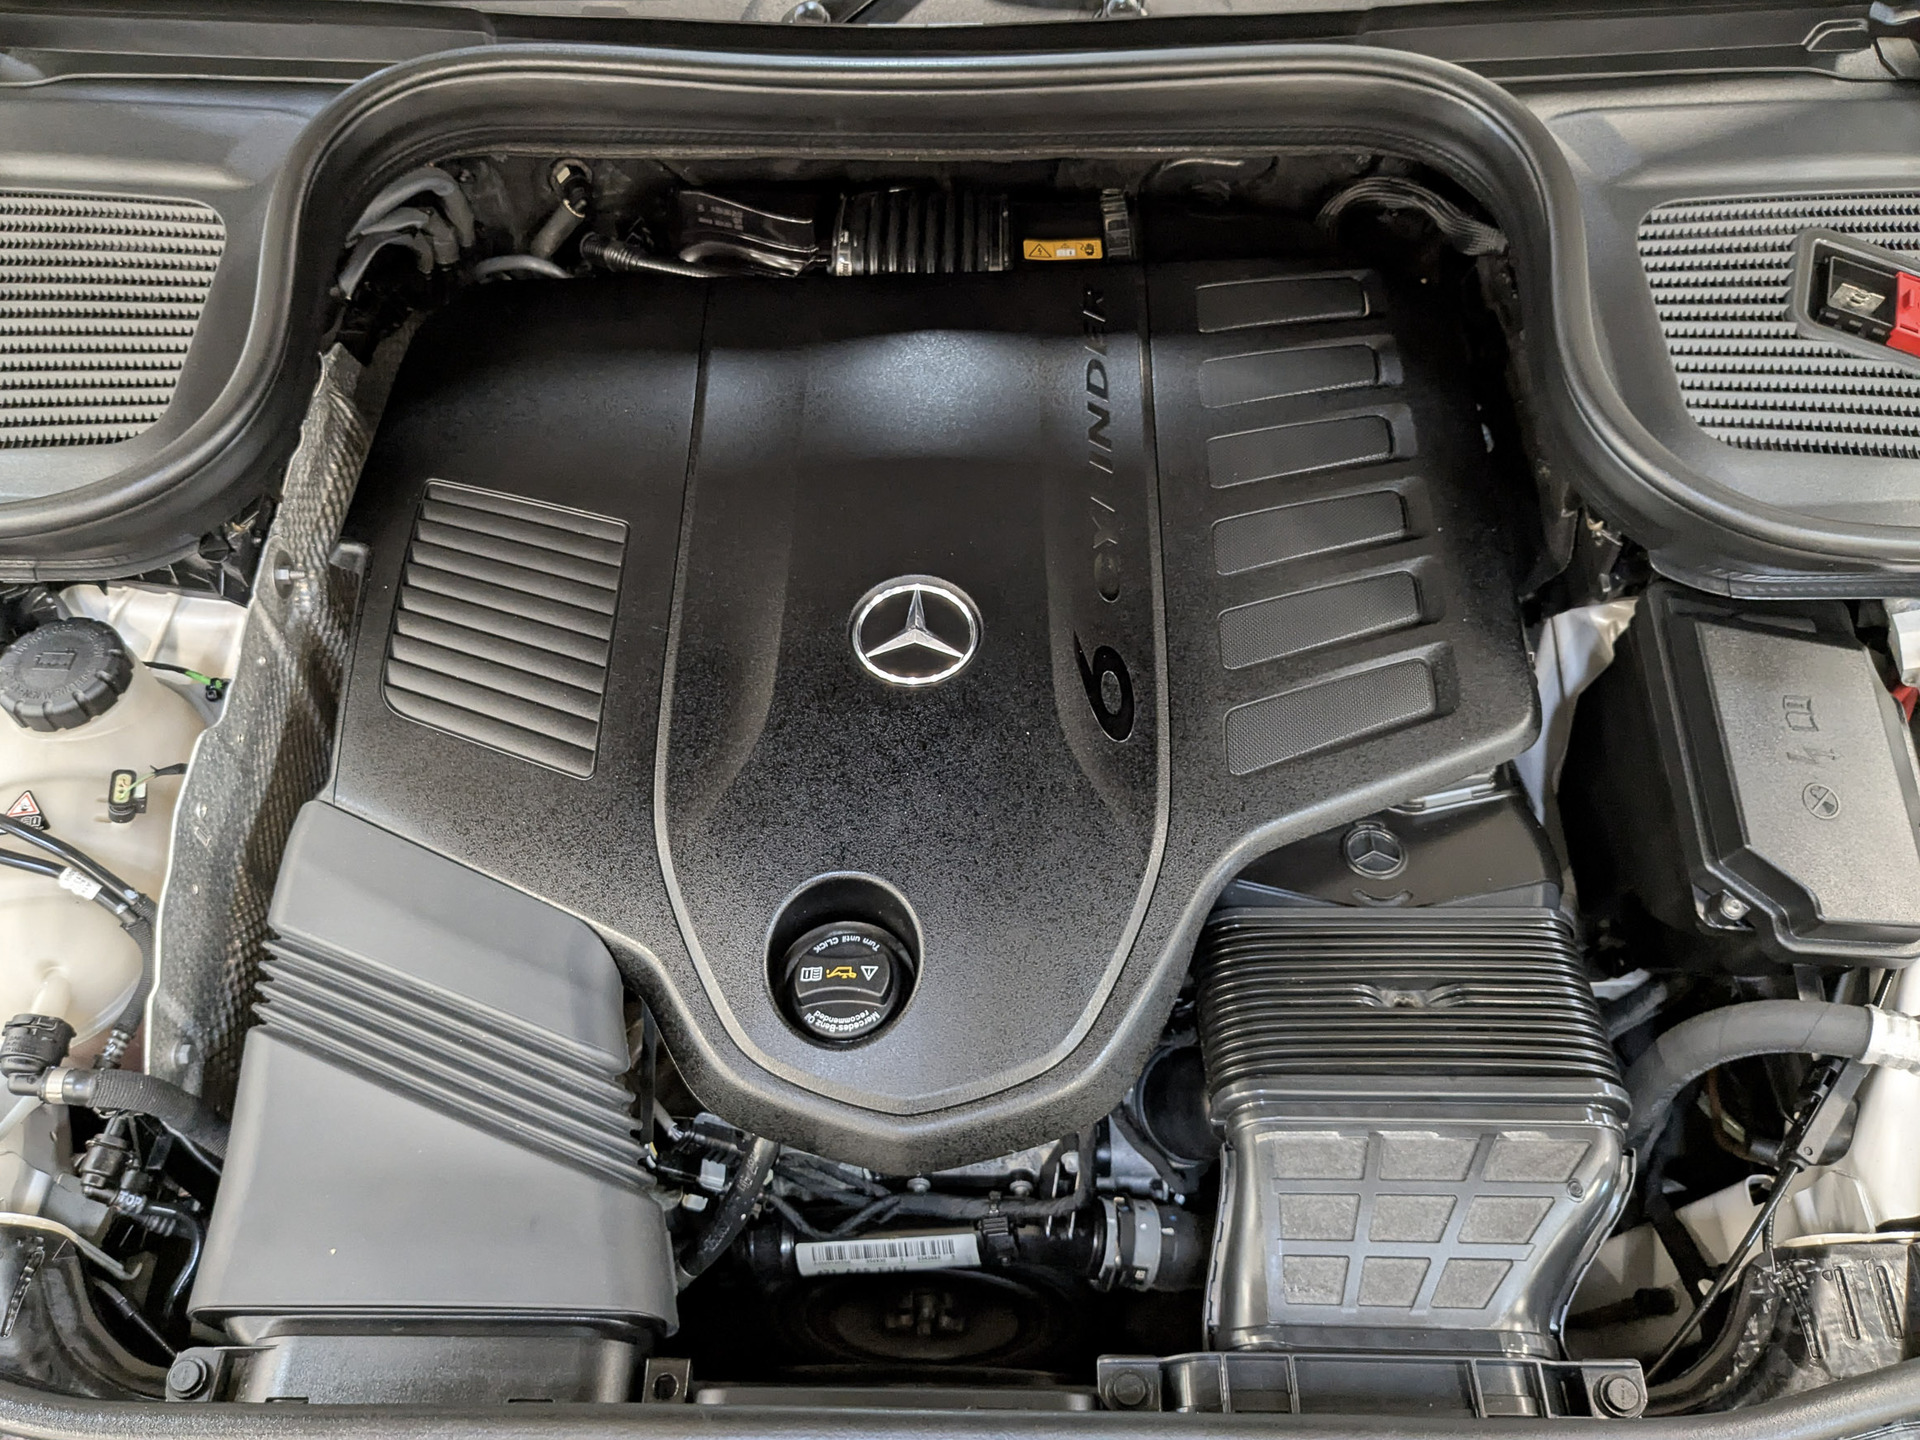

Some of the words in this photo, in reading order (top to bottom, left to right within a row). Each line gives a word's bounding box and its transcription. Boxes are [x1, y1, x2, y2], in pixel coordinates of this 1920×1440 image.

[1072, 629, 1135, 743] 6
[813, 936, 839, 954] CLICK
[842, 935, 861, 943] until
[862, 937, 880, 952] Turn
[804, 1012, 816, 1024] Oil
[815, 1010, 869, 1024] recommended
[815, 1011, 880, 1033] Mercedes-Benz
[119, 1190, 142, 1207] TOP
